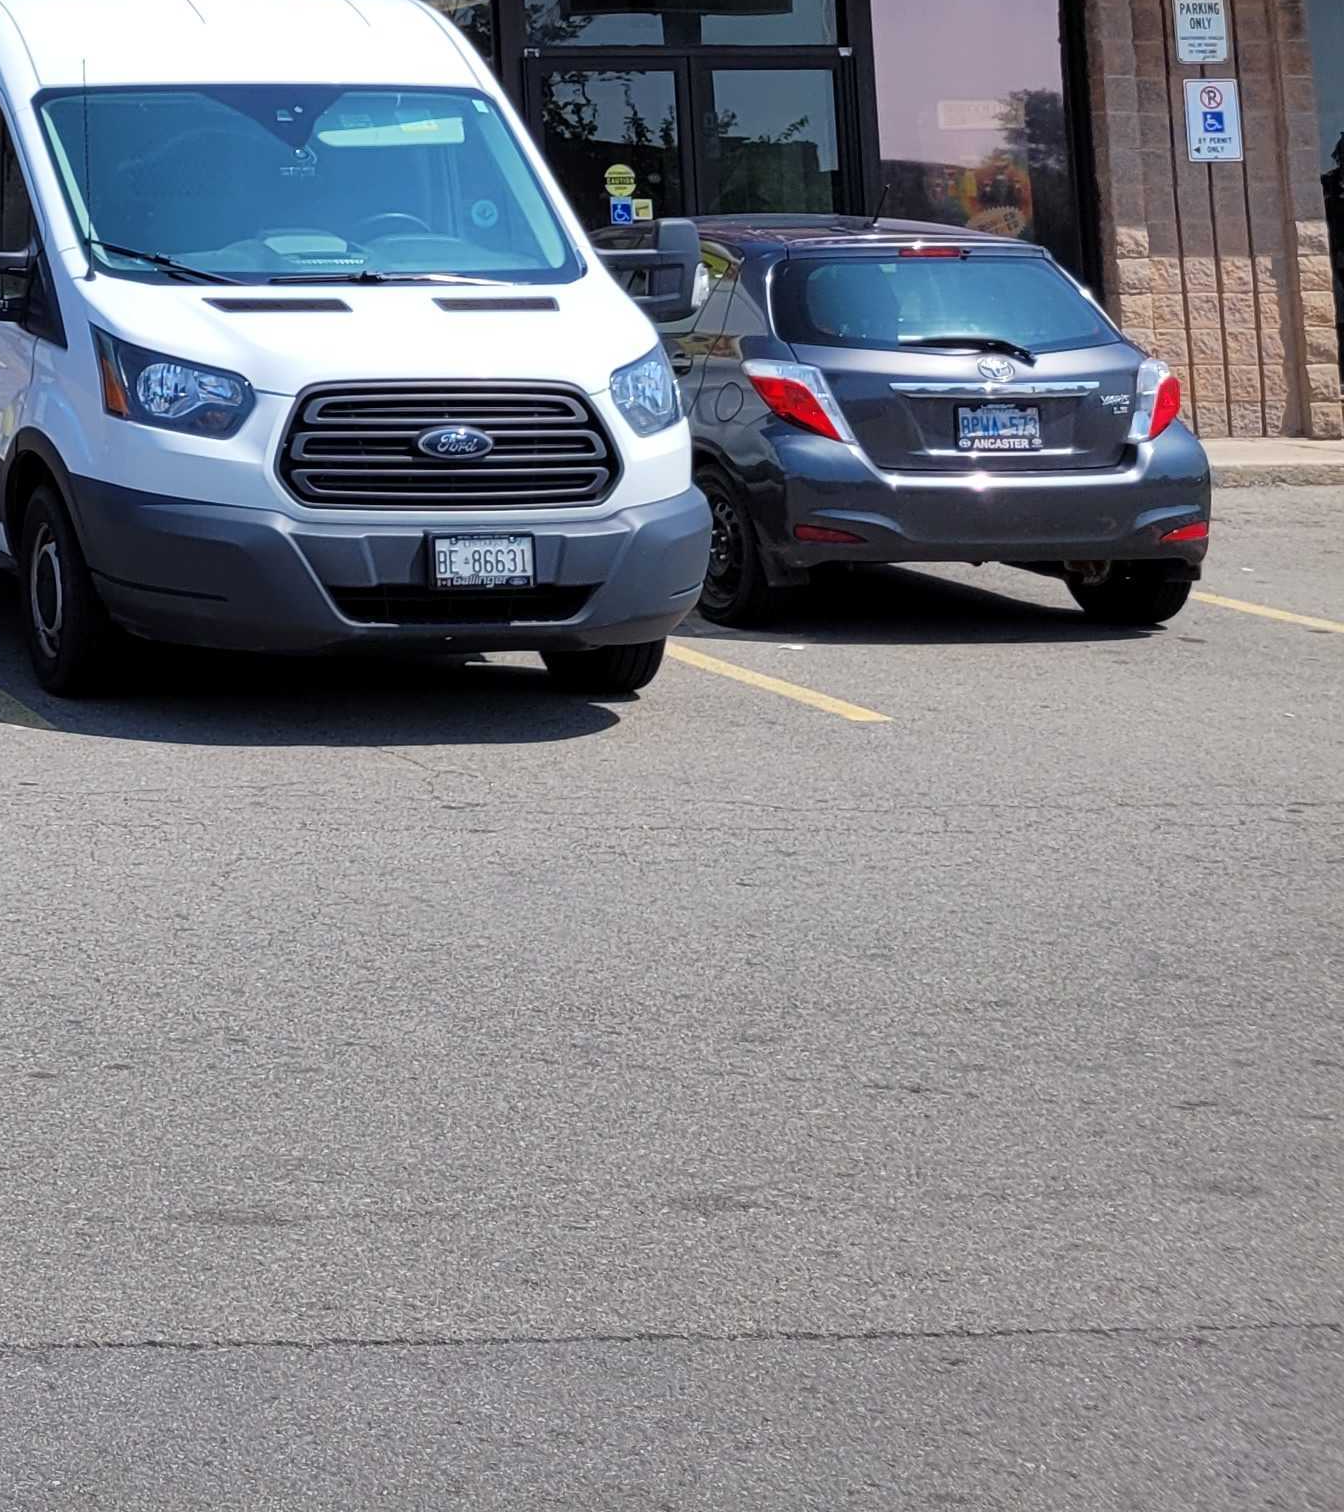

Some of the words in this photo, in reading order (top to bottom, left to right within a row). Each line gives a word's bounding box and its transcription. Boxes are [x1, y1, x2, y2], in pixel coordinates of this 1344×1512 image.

[1179, 3, 1220, 15] PARKING
[1189, 17, 1212, 30] ONLY
[437, 433, 478, 452] Ford
[973, 439, 1030, 449] ANCASTER
[437, 549, 460, 575] BE
[471, 548, 528, 574] 86631
